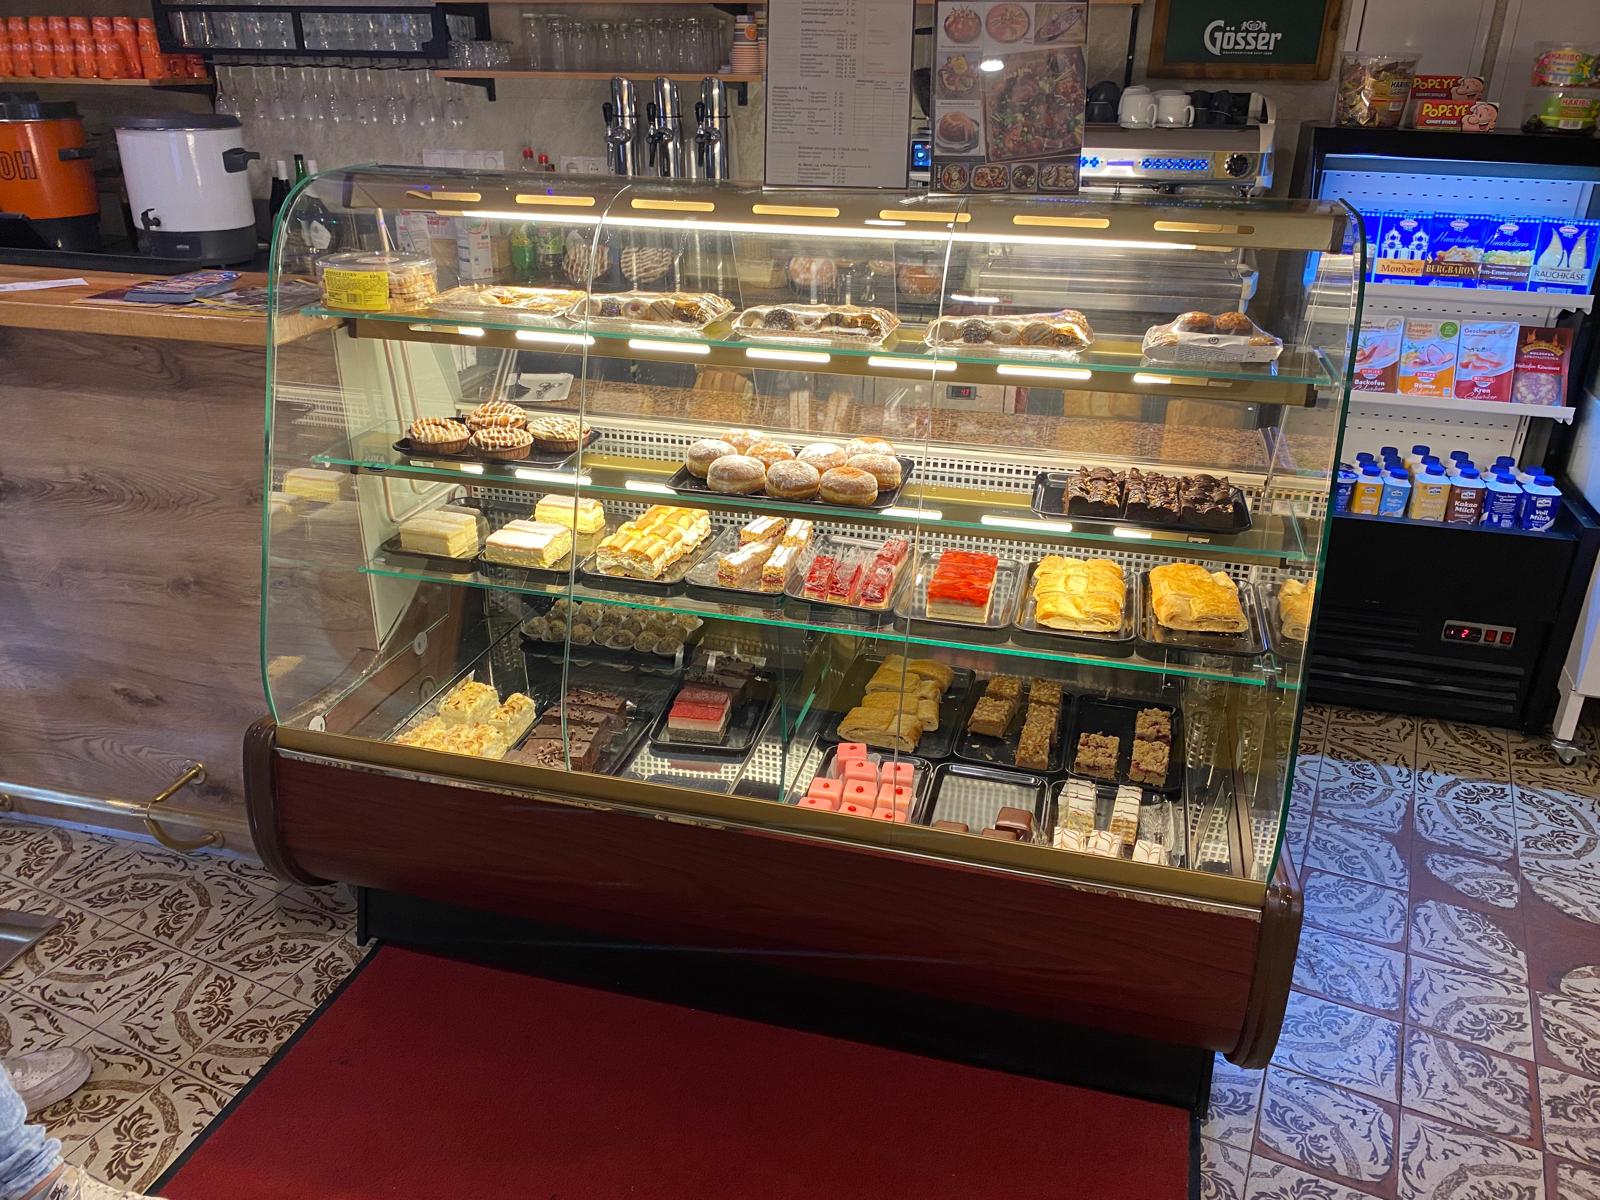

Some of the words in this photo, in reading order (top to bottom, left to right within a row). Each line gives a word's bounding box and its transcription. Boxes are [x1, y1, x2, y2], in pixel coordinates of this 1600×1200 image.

[1203, 19, 1282, 56] Gösser
[1422, 103, 1469, 117] POPEYE
[1425, 264, 1476, 276] BERGBARON
[1454, 506, 1475, 514] Milch
[1461, 629, 1469, 638] 2
